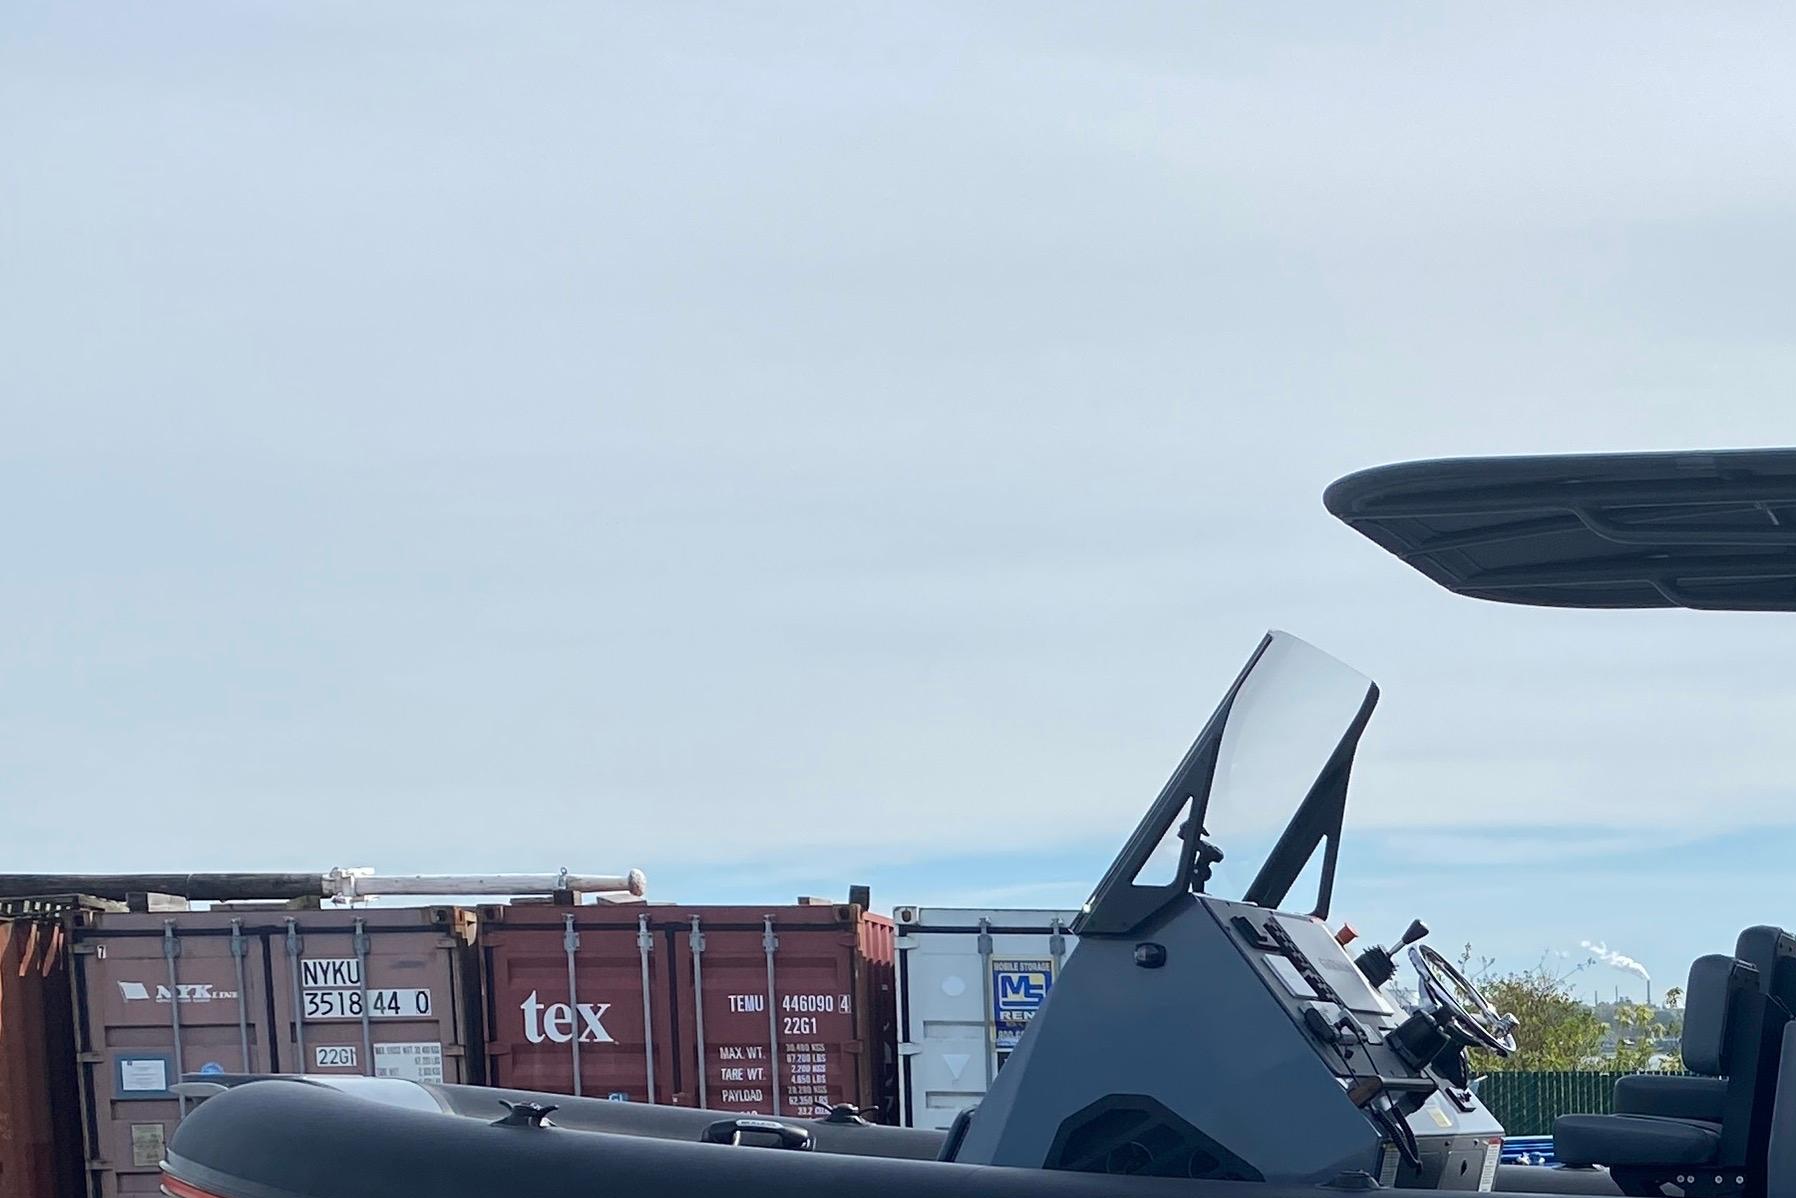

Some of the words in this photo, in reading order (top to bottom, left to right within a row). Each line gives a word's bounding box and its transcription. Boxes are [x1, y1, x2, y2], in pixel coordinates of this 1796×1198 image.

[303, 960, 360, 985] NYKU
[1019, 962, 1051, 971] STORAGE
[156, 984, 213, 999] NYK
[728, 994, 764, 1013] TEMU
[782, 994, 834, 1012] 446090
[839, 995, 850, 1013] 4
[519, 989, 614, 1044] tex
[999, 1011, 1037, 1020] REN
[783, 1017, 818, 1035] 22G1
[812, 1053, 827, 1063] LBS
[721, 1068, 746, 1081] TARE
[812, 1074, 827, 1084] LBS
[722, 1089, 763, 1103] PAYLOAD
